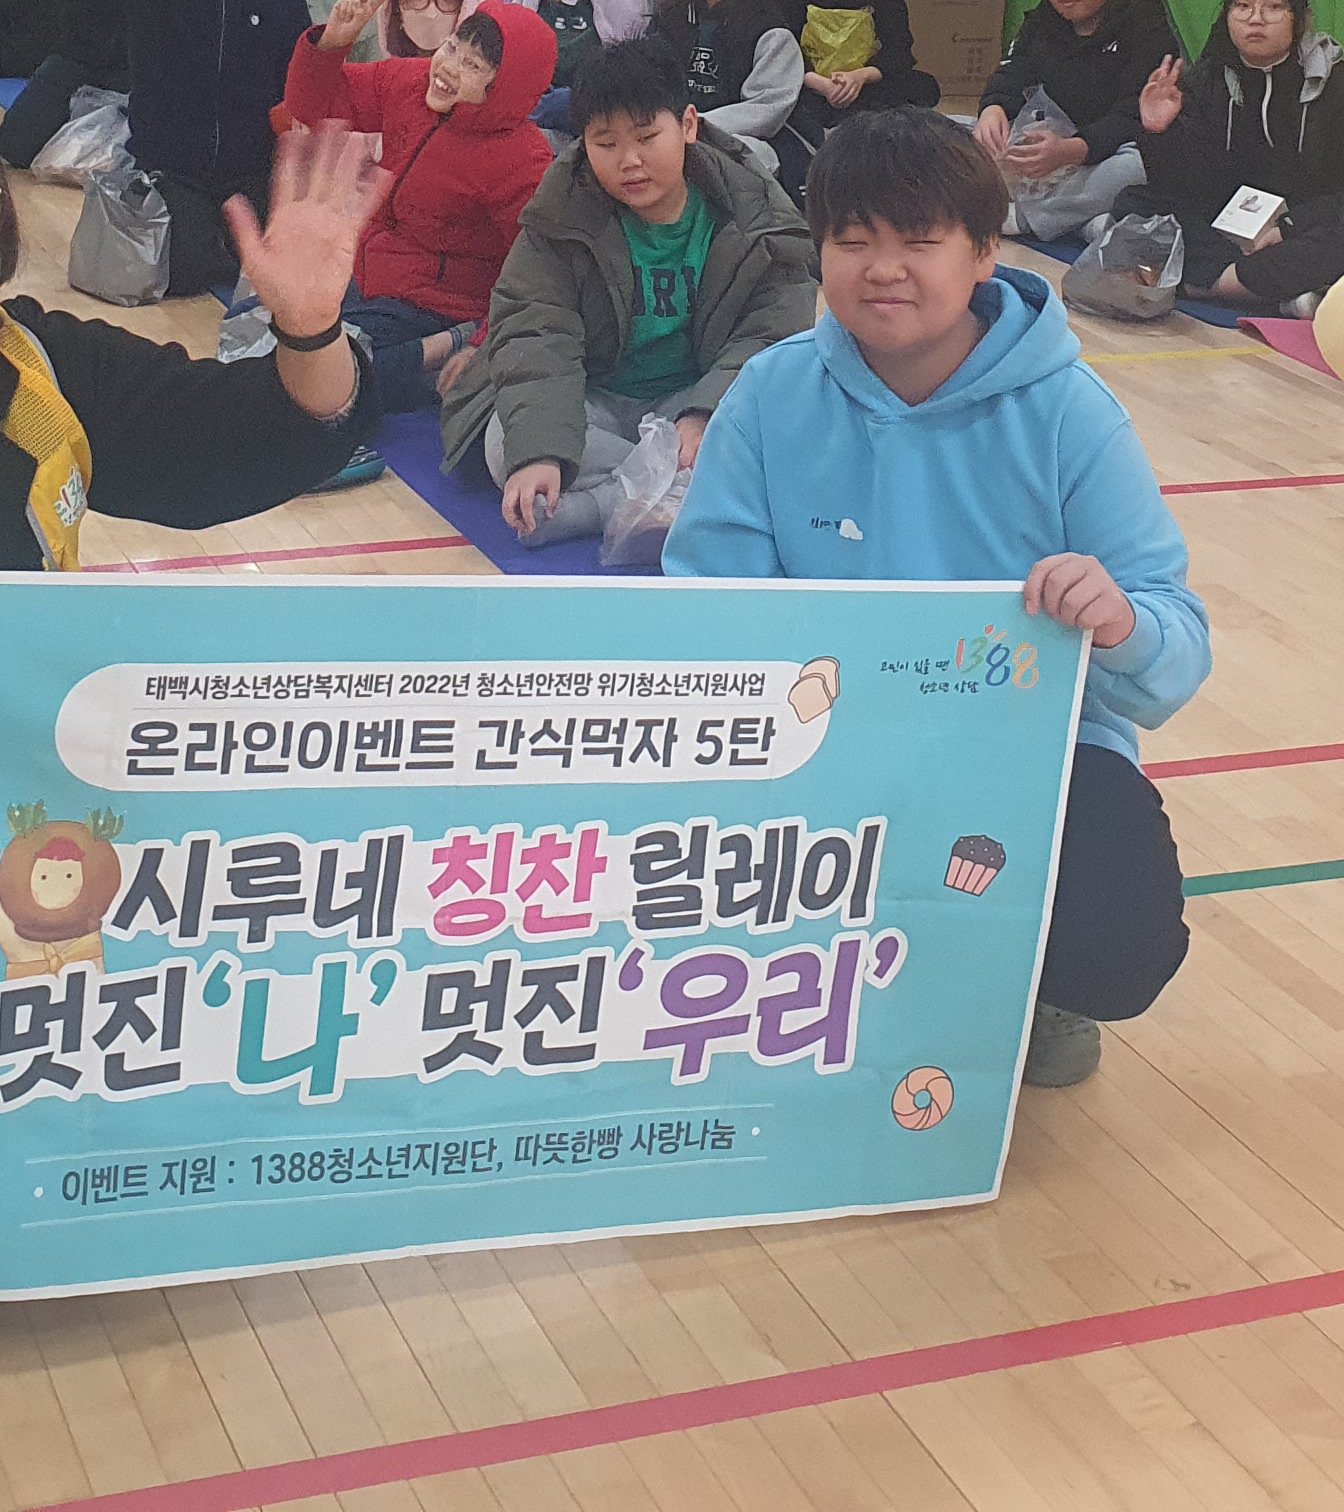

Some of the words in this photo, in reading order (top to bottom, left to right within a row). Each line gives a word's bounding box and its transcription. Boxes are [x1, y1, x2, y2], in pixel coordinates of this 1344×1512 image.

[144, 674, 393, 701] 태백시청소년상담복지센터
[398, 673, 470, 698] 2022년
[475, 672, 594, 698] 청소년안전망
[597, 672, 766, 698] 위기청소년지원사업
[956, 636, 1039, 689] 1388
[126, 718, 456, 776] 온라인이벤트
[475, 717, 679, 770] 간식먹자
[694, 716, 777, 766] 5탄
[111, 834, 406, 944] 시루네
[426, 827, 609, 937] 칭찬
[629, 824, 882, 931] 릴레이
[61, 1164, 149, 1206] 이벤트
[159, 1155, 217, 1196] 지원
[250, 1137, 504, 1186] 1388청소년지원단,
[514, 1125, 624, 1168] 따뜻한빵
[629, 1118, 736, 1156] 사랑나눔
